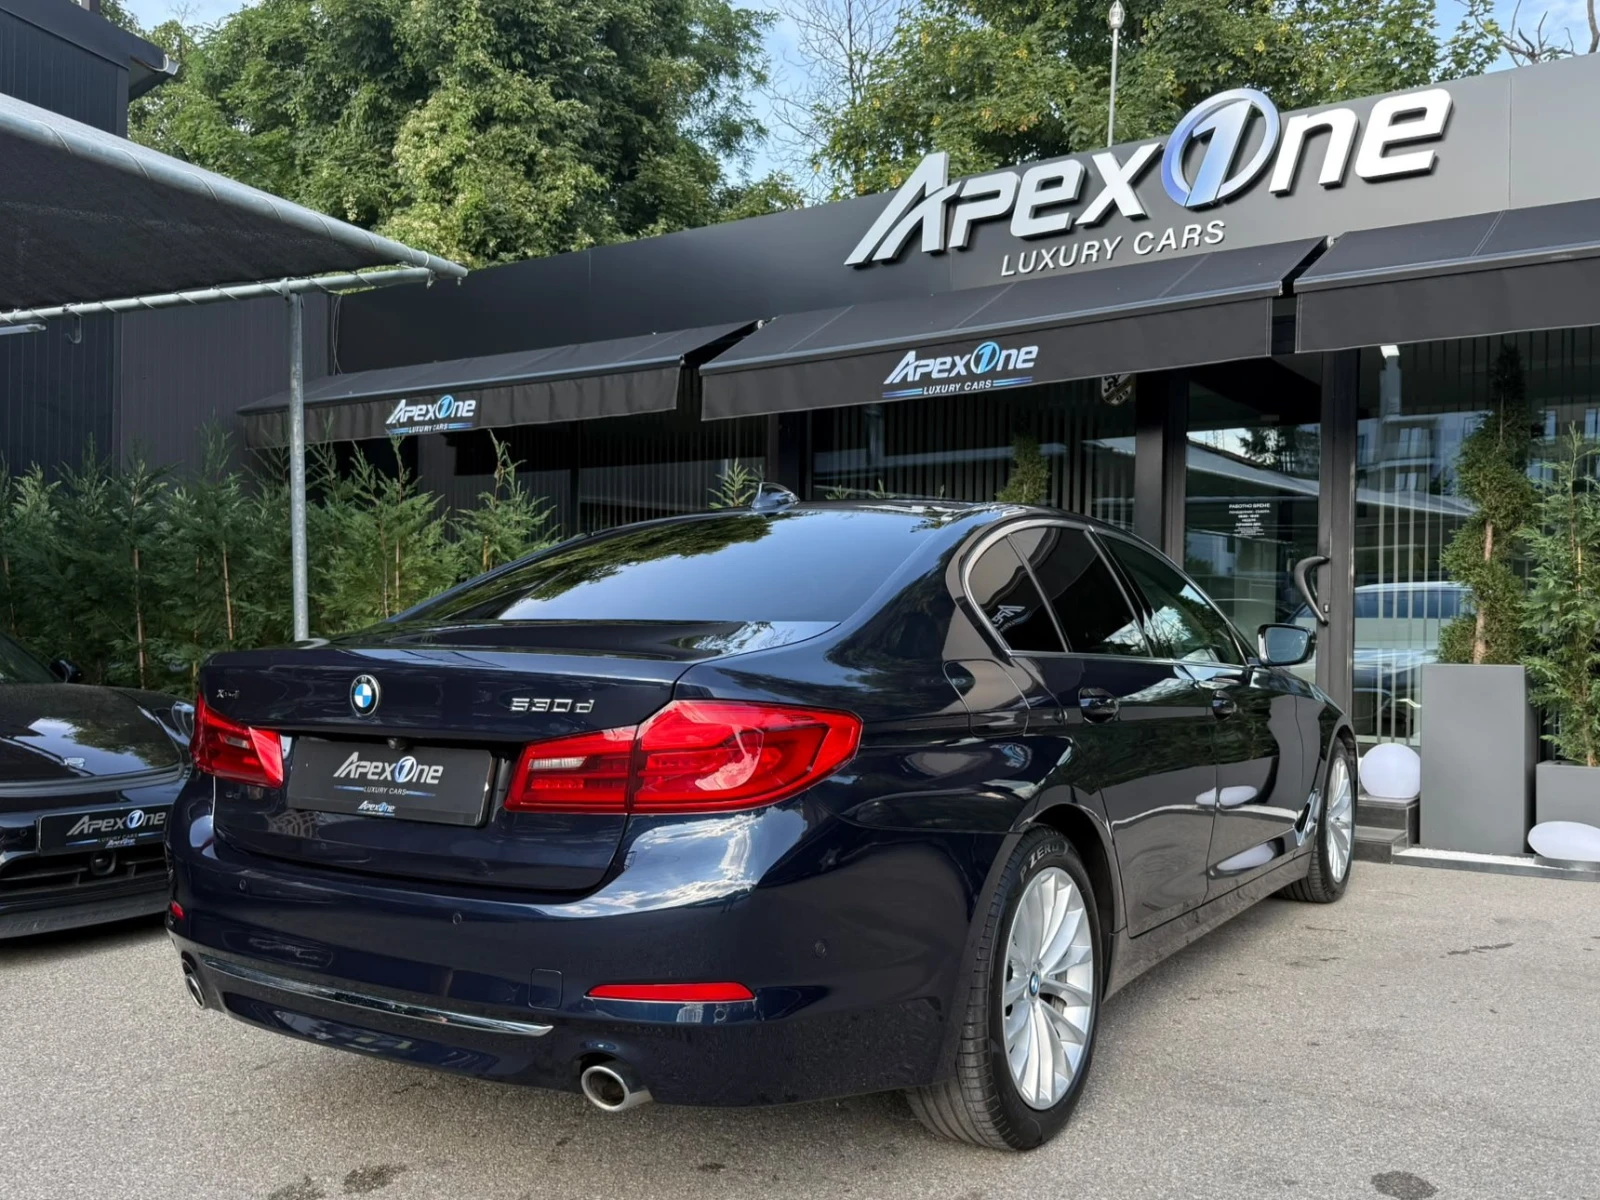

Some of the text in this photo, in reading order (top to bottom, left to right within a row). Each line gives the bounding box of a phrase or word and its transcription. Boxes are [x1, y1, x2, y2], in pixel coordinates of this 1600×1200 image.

[1000, 219, 1226, 277] LUXURY CARS
[923, 379, 992, 395] LUXURY CARS
[408, 425, 432, 434] LUXURY
[363, 785, 407, 796] LUXURY CARS
